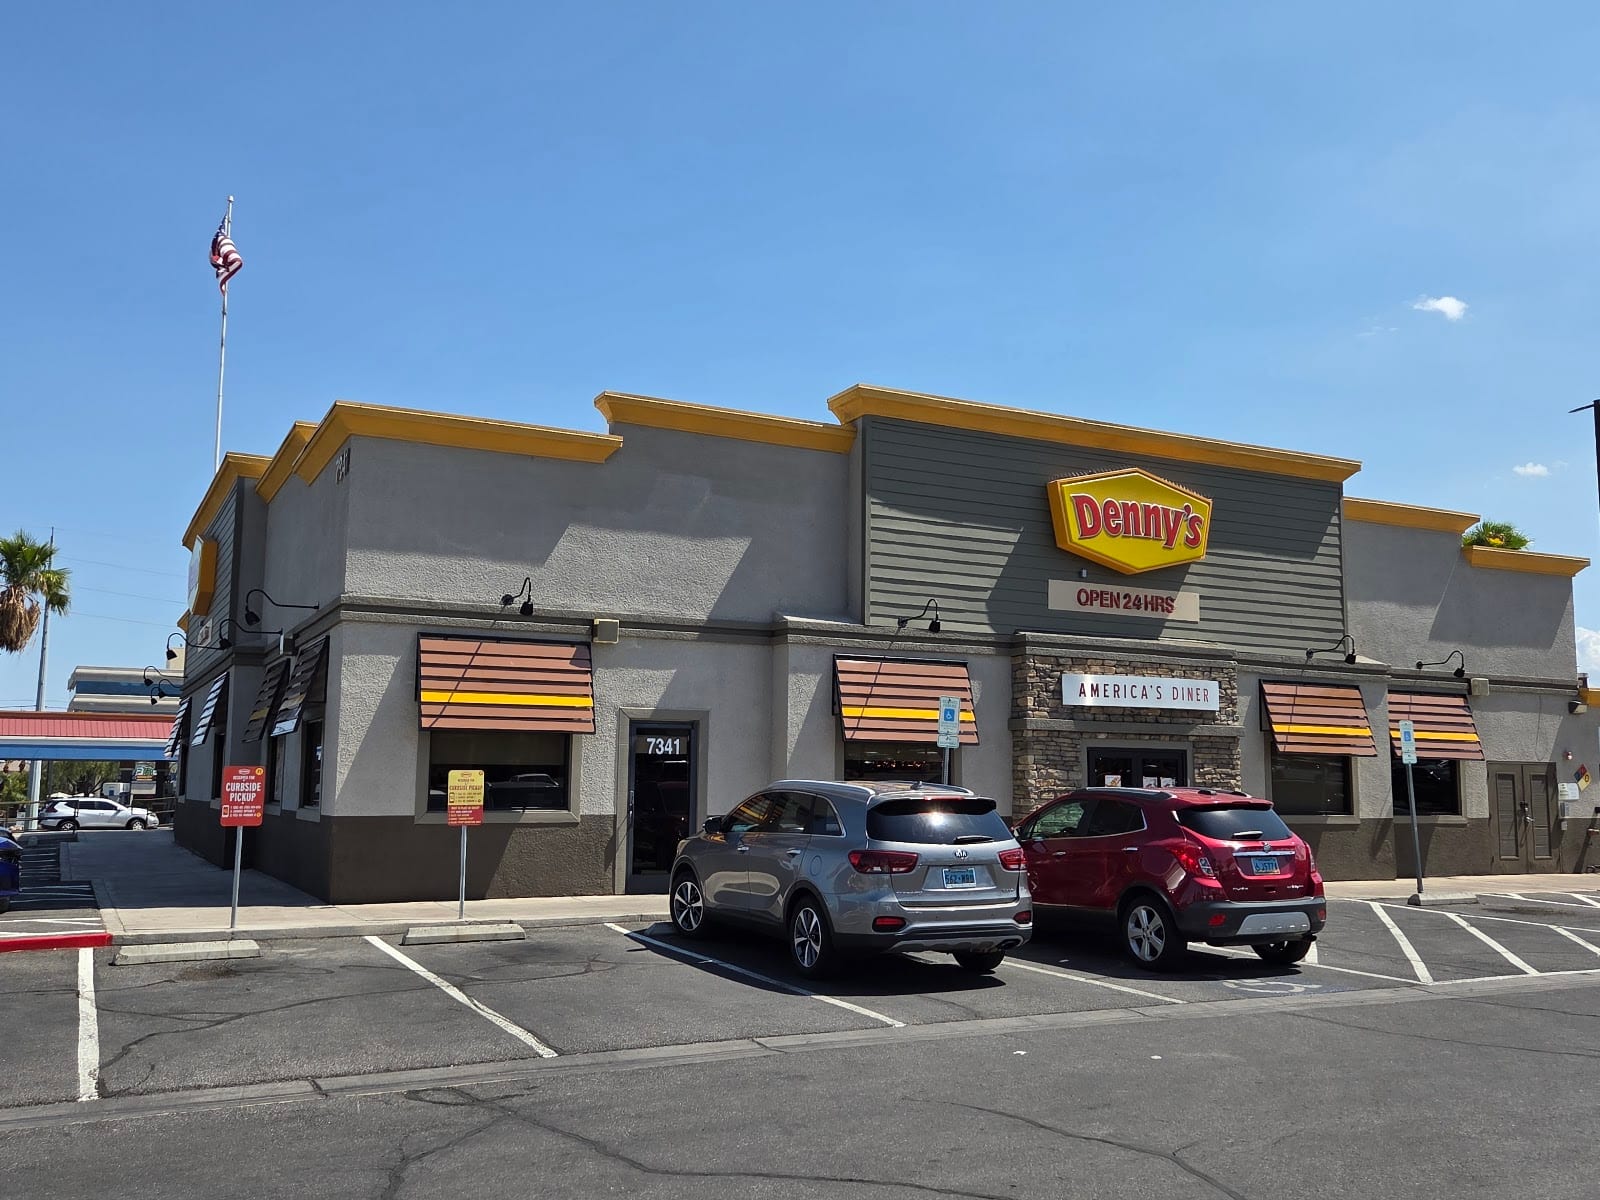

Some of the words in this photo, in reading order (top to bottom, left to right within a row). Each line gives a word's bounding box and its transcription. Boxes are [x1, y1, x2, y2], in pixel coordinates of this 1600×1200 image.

[1070, 493, 1204, 549] Denny's
[1076, 588, 1120, 609] OPEN
[1122, 592, 1142, 610] 24
[1143, 594, 1175, 613] HRS
[1079, 682, 1162, 700] AMERICA'S
[1172, 686, 1209, 703] DINER
[646, 737, 680, 755] 7341
[225, 782, 261, 791] CURBSIDE
[229, 792, 256, 802] PICKUP
